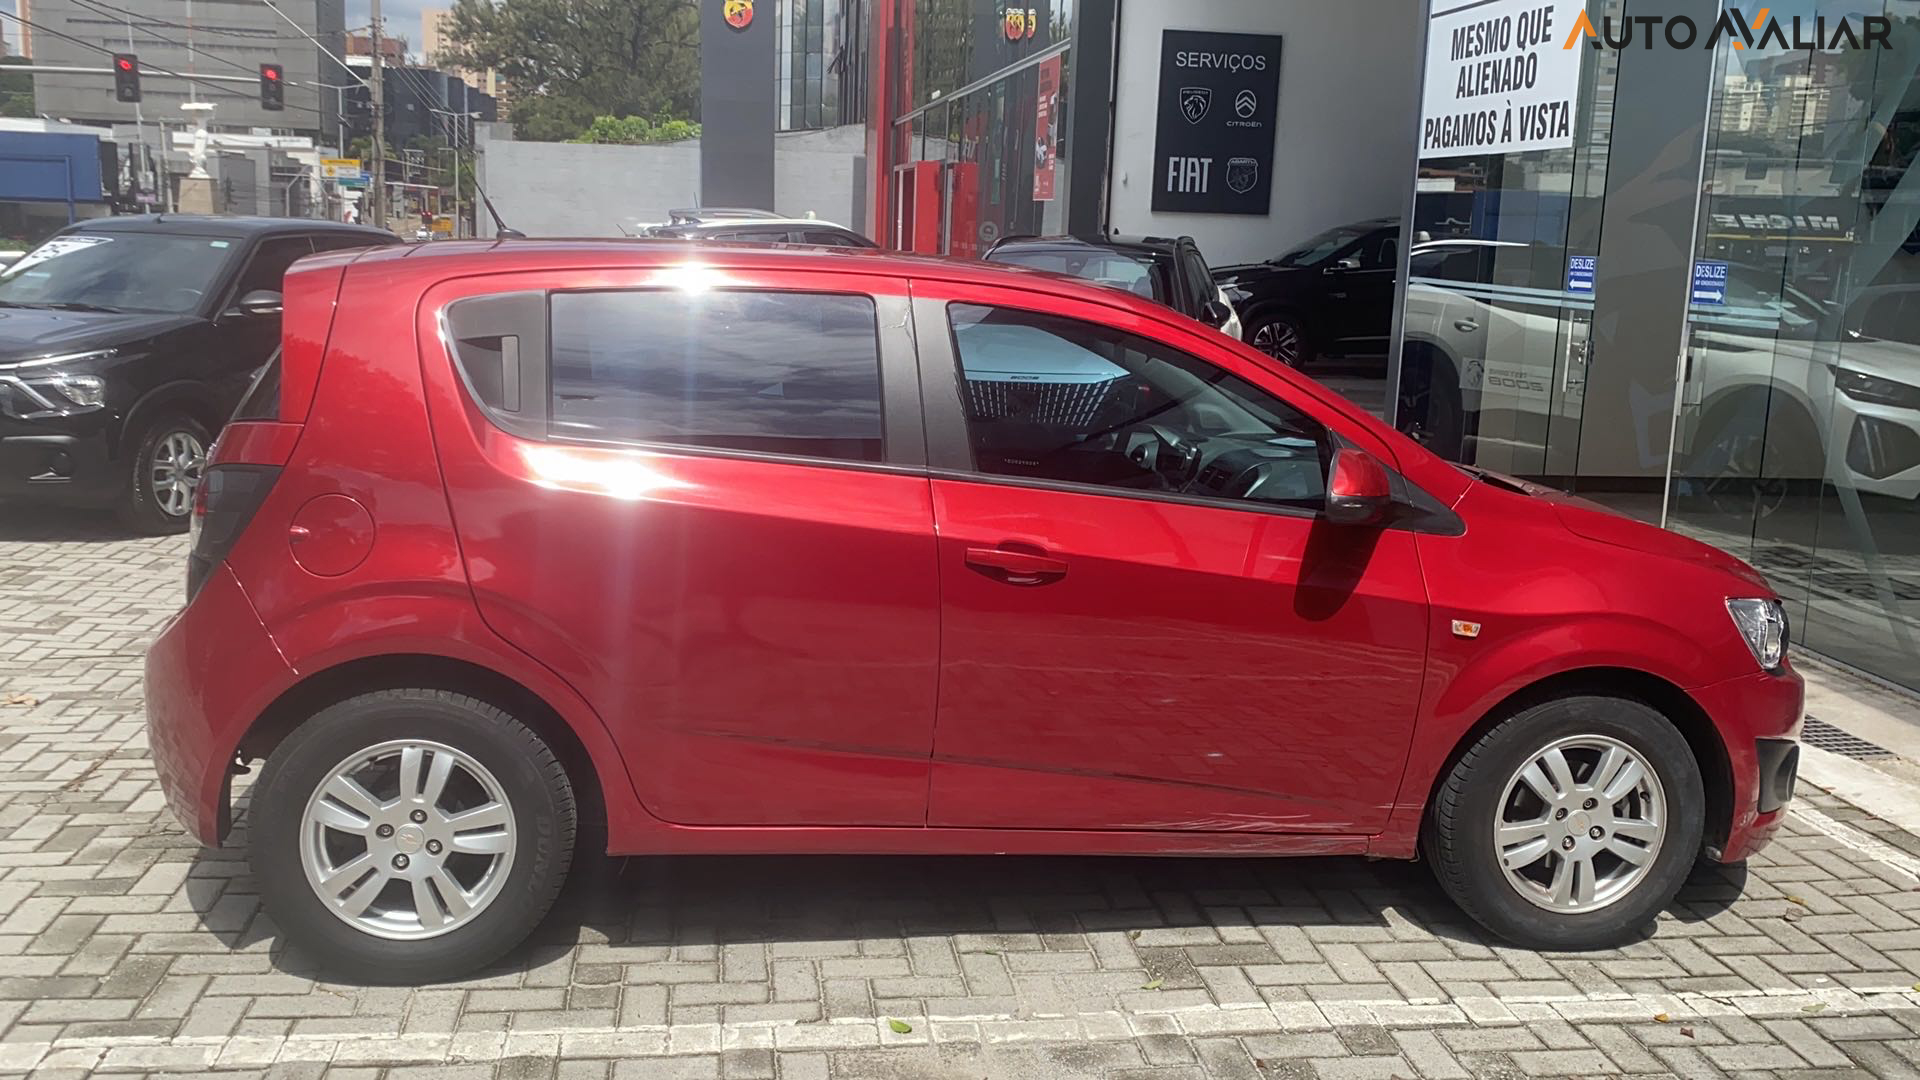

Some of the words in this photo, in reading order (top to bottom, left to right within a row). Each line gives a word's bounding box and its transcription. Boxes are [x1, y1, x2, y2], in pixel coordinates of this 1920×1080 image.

[1450, 15, 1511, 62] MESMO
[1516, 5, 1554, 51] QUE
[1175, 51, 1266, 73] SERVIÇOS
[1455, 51, 1538, 99] ALIENADO
[1423, 110, 1497, 150] PAGAMOS
[1500, 99, 1512, 144] À
[1519, 100, 1569, 142] VISTA
[1167, 156, 1213, 193] FIAT
[1570, 258, 1595, 270] DESLIZE
[1695, 265, 1726, 279] DESLIZE
